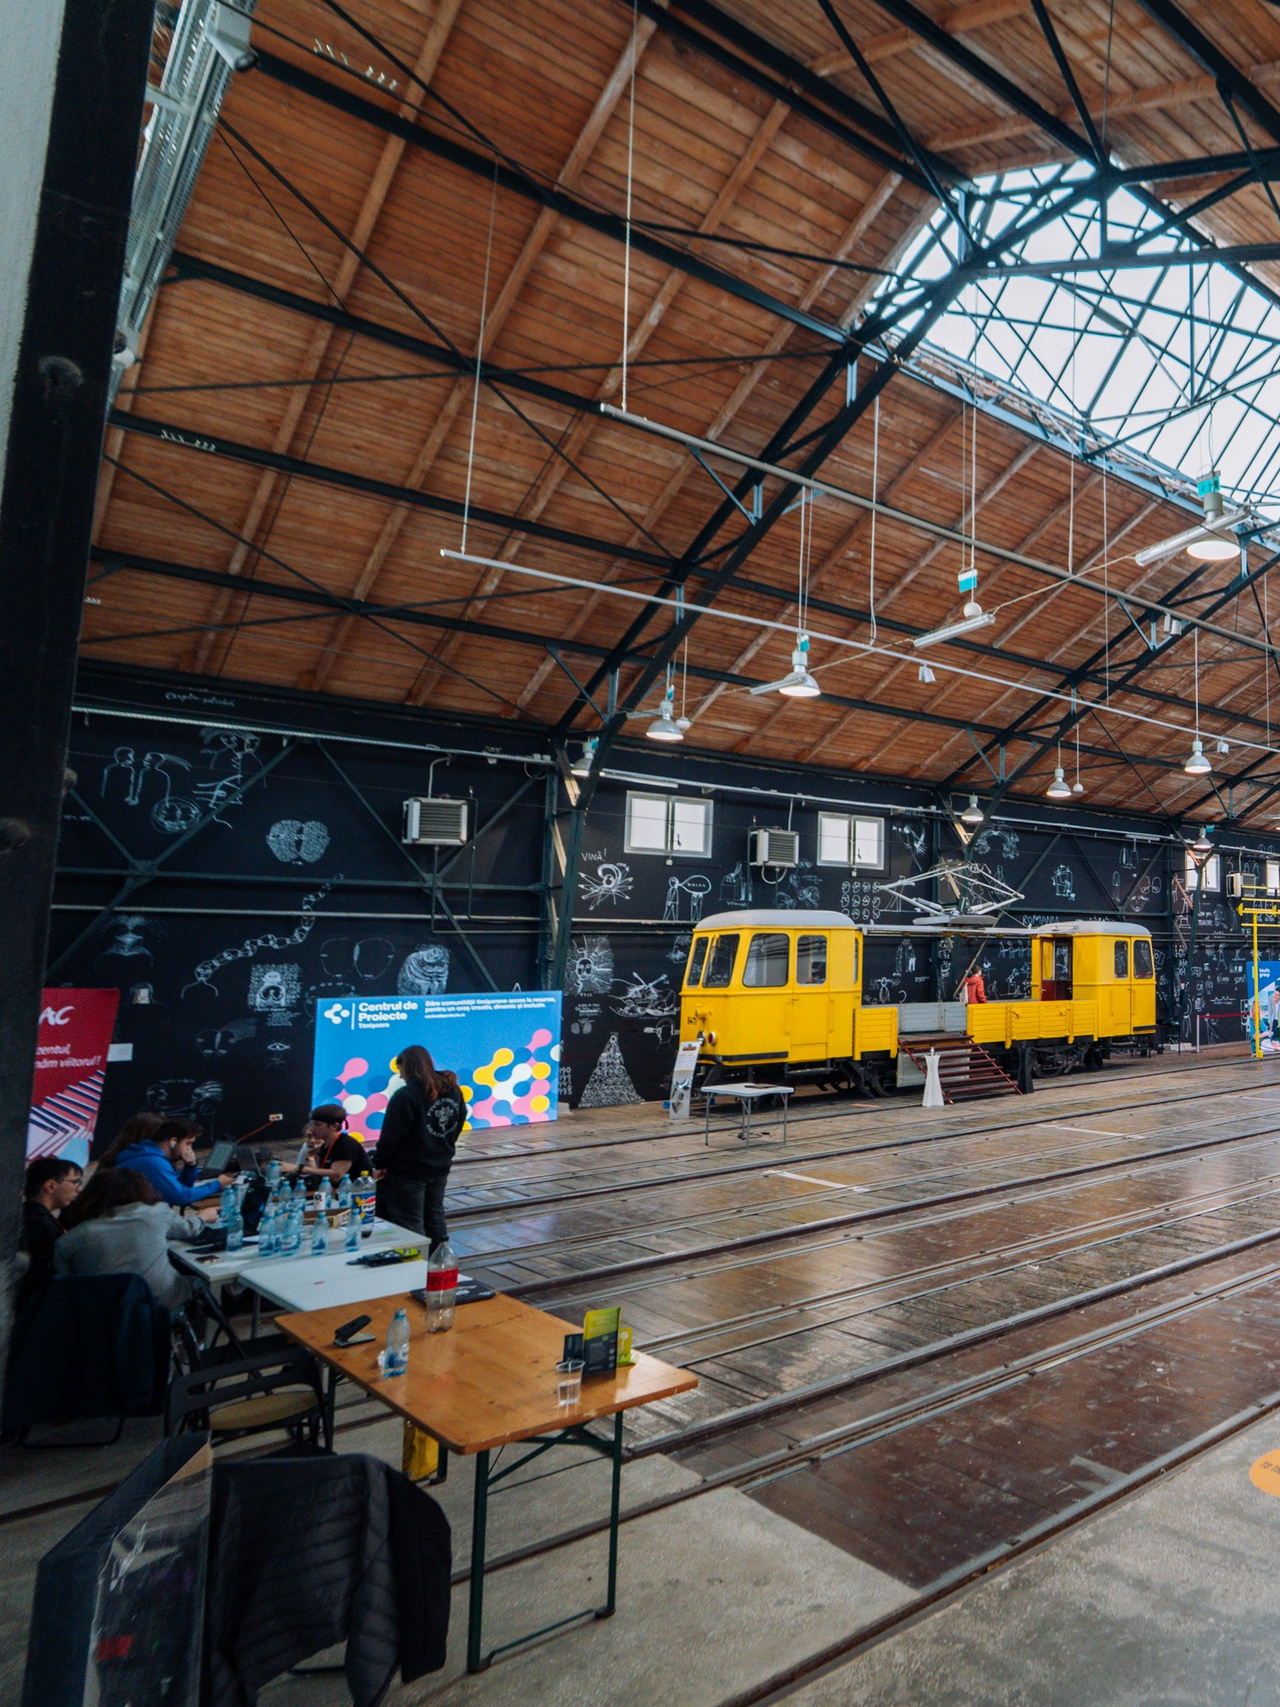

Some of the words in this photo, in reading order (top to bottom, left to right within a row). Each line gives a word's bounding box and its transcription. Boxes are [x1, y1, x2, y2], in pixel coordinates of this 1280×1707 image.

[358, 1001, 402, 1012] Centrul
[402, 1001, 418, 1010] de
[358, 1012, 408, 1022] Proiecte
[1260, 1461, 1273, 1469] TO
